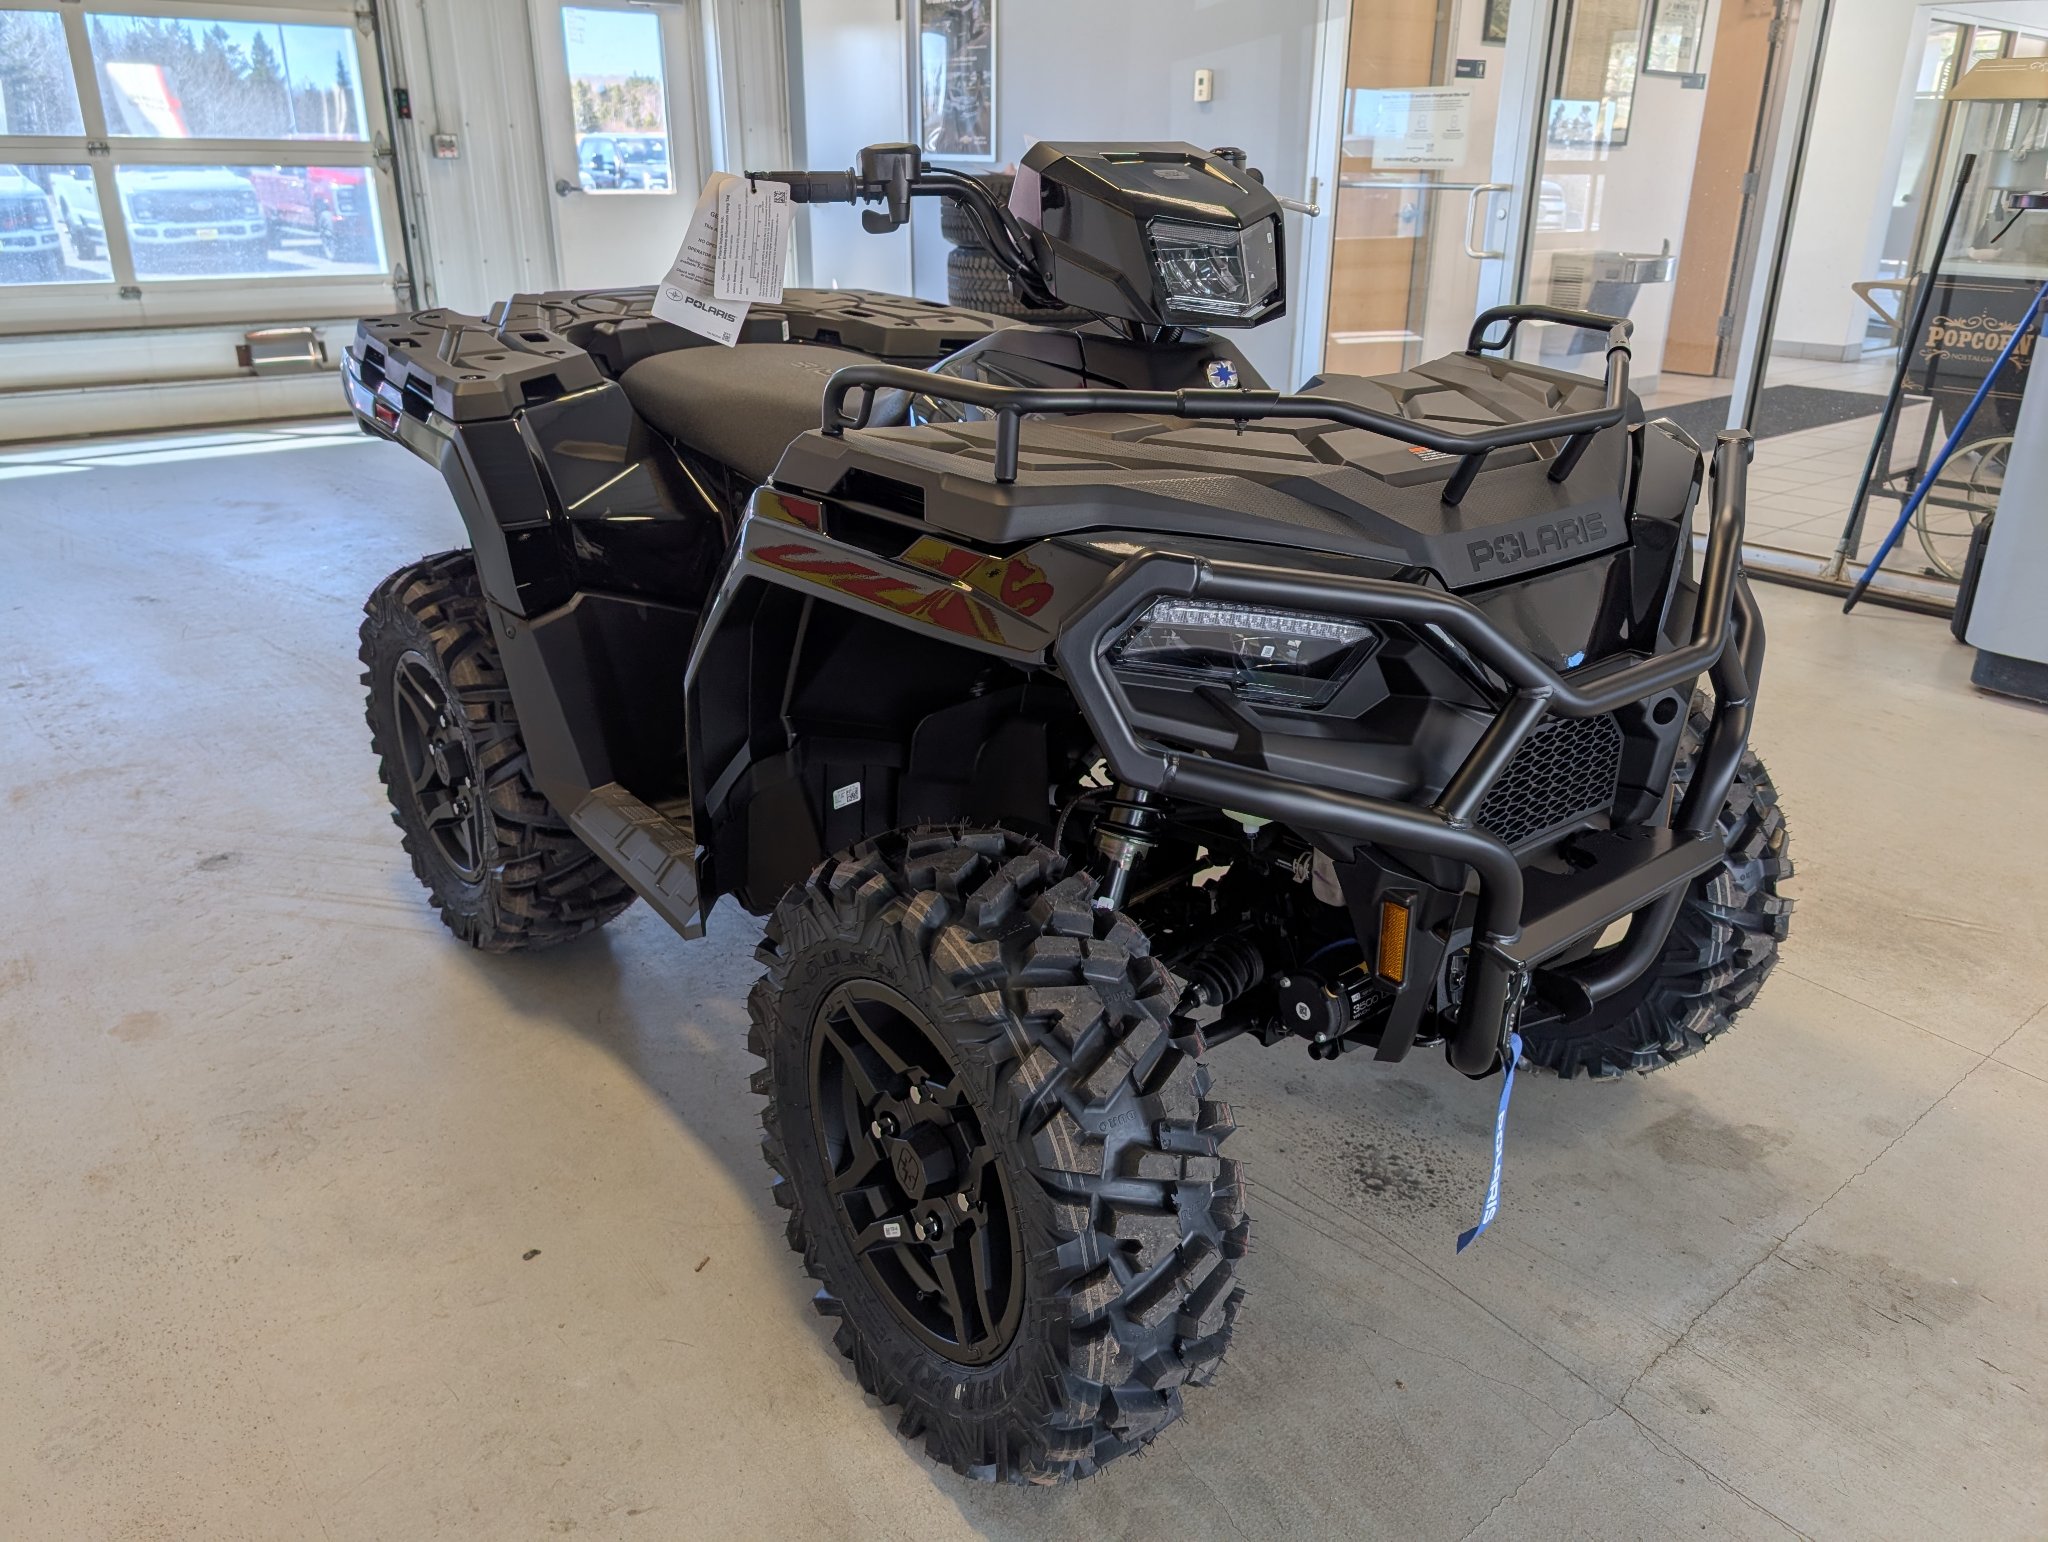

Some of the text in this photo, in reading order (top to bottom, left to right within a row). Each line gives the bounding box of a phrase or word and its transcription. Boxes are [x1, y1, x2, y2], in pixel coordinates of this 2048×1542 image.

[685, 296, 737, 323] POLARIS
[1466, 511, 1608, 572] POLARIS
[1353, 995, 1379, 1014] 3500
[1482, 1109, 1506, 1225] POLARIS
